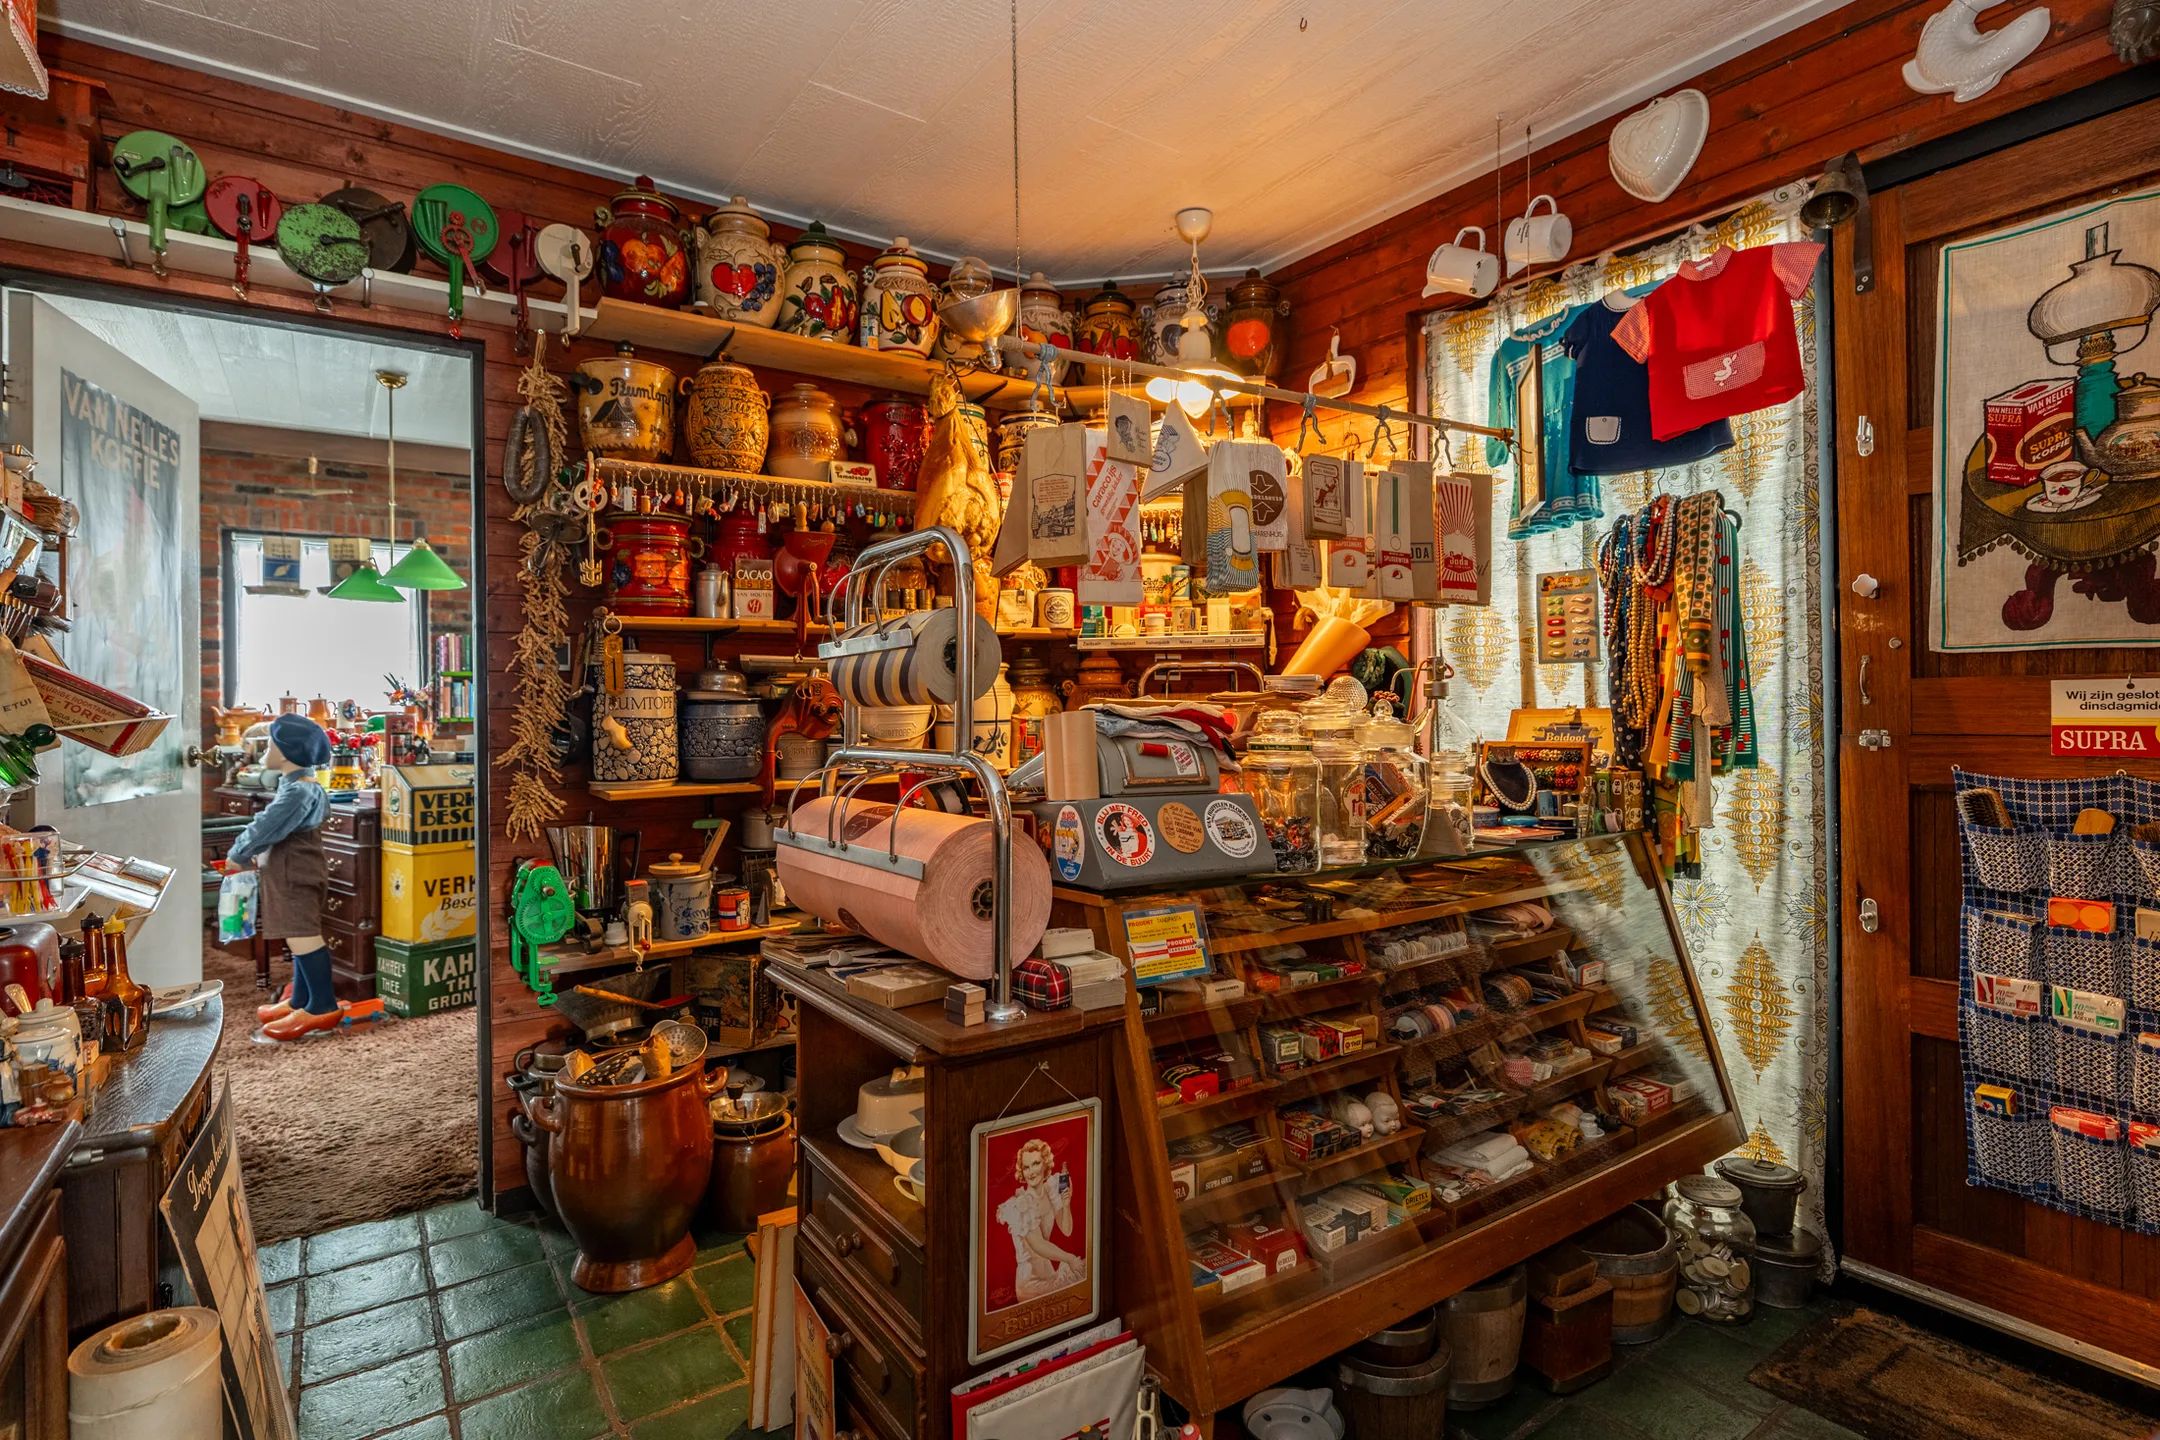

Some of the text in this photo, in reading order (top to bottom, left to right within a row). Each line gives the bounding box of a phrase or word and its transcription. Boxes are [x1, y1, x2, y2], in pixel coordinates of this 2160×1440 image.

[63, 376, 108, 431] VAN
[610, 377, 672, 417] Rumtopf
[1987, 406, 2000, 414] VAN
[2027, 401, 2045, 414] VAN
[1987, 413, 2022, 423] SUPRA
[2032, 437, 2071, 462] KOFFIE
[90, 430, 160, 490] KOFFIE
[1092, 475, 1112, 508] caraco
[736, 569, 773, 581] CACAO
[2066, 690, 2160, 701] Wij zijn geslot
[2, 698, 32, 713] ETUI
[1546, 732, 1586, 742] Boldoot
[2060, 730, 2147, 750] SUPRA
[1097, 808, 1109, 825] BLIJ
[1109, 804, 1126, 813] MET
[1127, 806, 1148, 827] FRED
[1106, 845, 1153, 866] IN DE BUURT
[1128, 919, 1153, 928] PRODENT
[1166, 938, 1193, 946] PRODENT
[381, 977, 401, 995] THEE
[1290, 1127, 1308, 1142] LEGO
[1361, 1184, 1386, 1199] DRIETEX
[1405, 1192, 1429, 1205] DRIETEX
